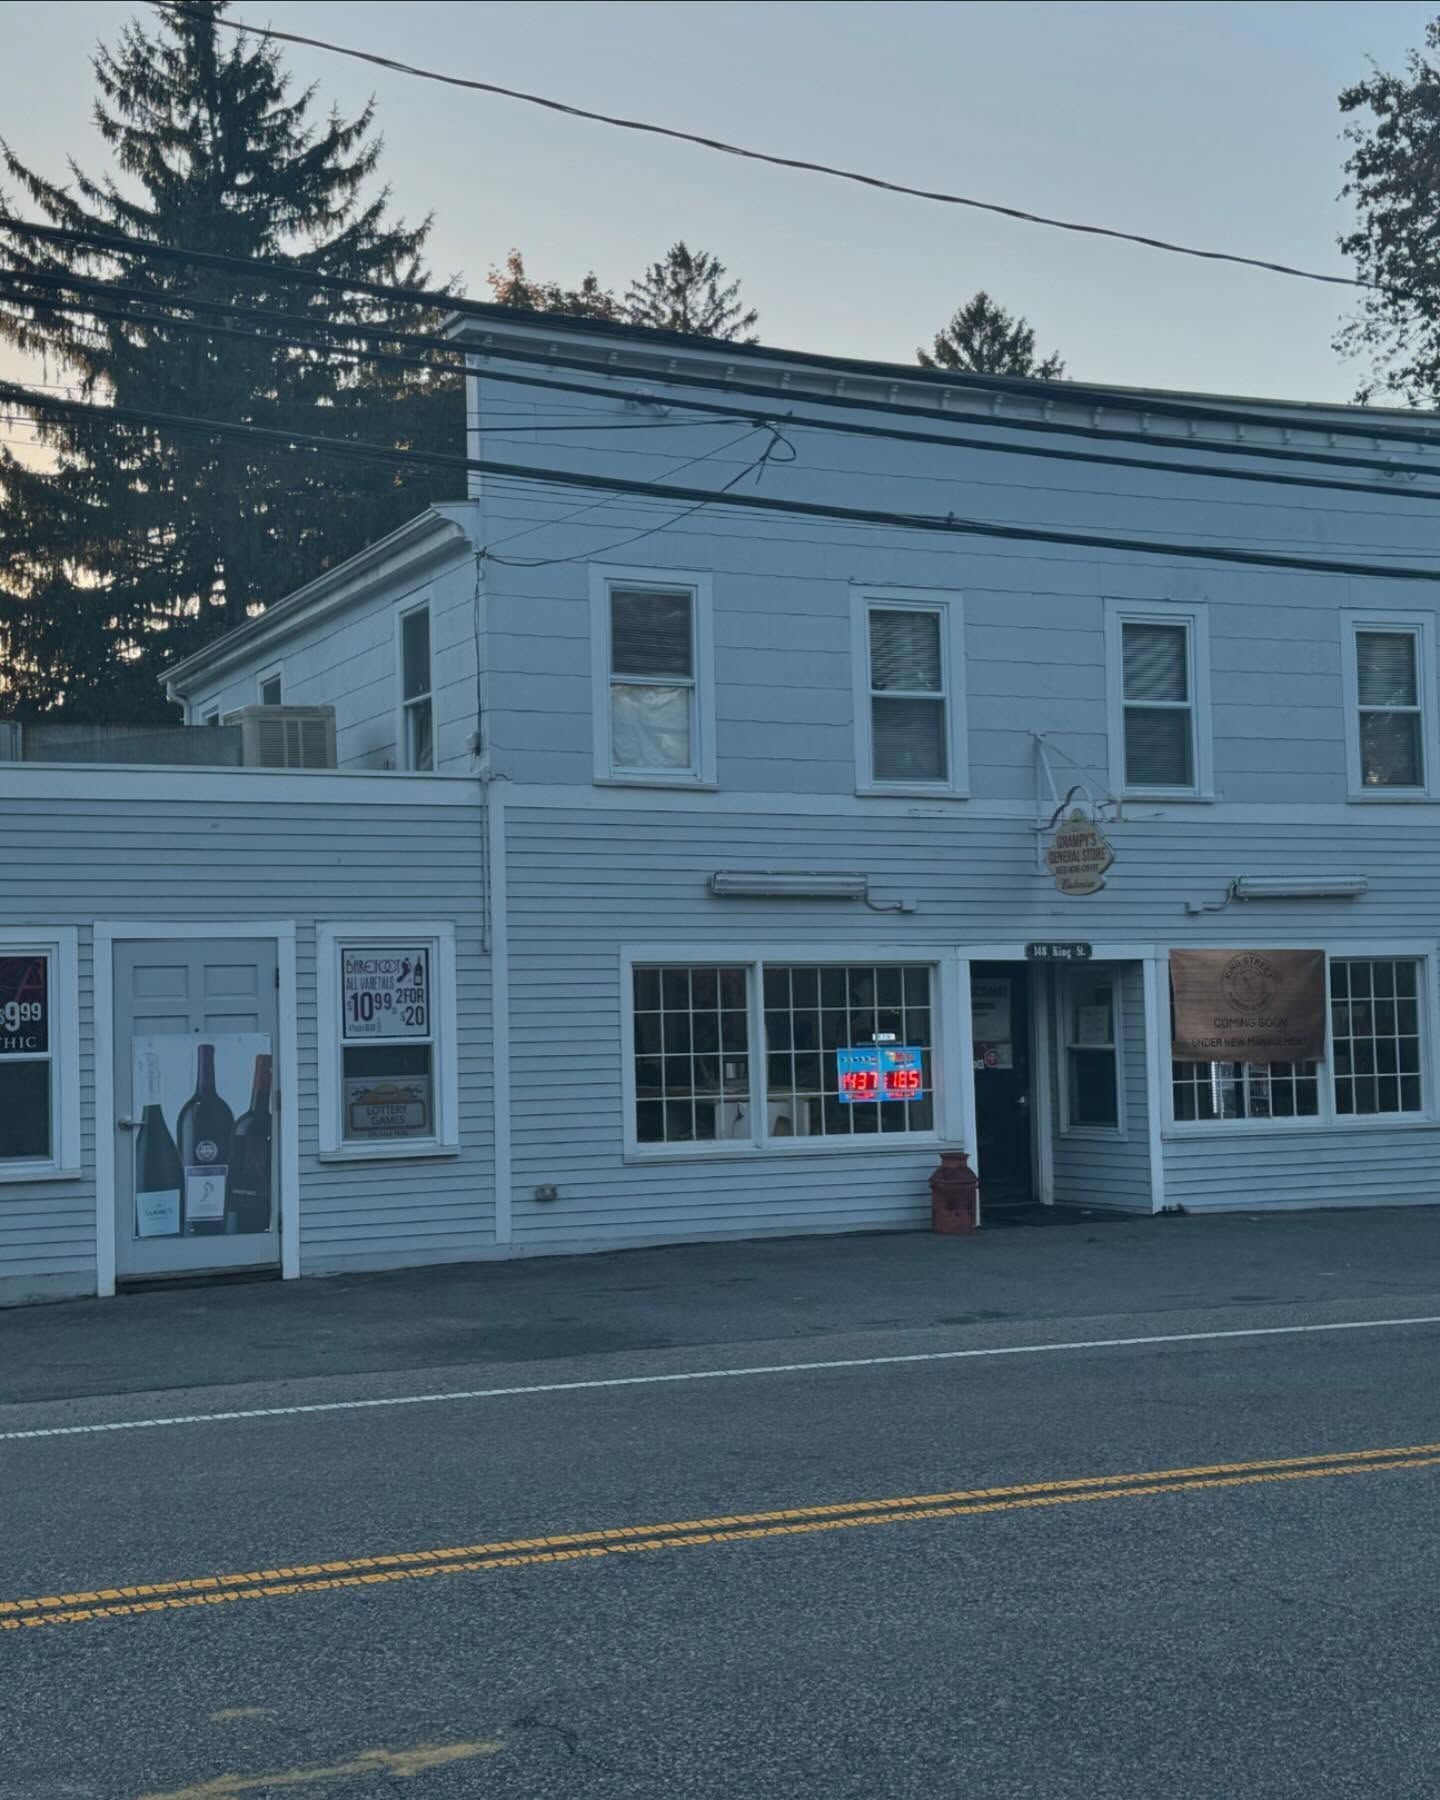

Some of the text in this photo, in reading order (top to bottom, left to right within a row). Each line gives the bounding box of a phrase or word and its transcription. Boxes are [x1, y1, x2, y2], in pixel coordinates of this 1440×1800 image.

[1048, 847, 1106, 865] GENERAL STORE
[1052, 945, 1072, 960] King
[346, 959, 401, 975] BAREFOOT
[346, 976, 360, 991] ALL
[400, 1005, 425, 1026] $20
[1213, 1016, 1289, 1030] COMING SOON
[0, 1036, 37, 1049] HIC
[1191, 1038, 1223, 1048] UNDER
[1224, 1038, 1245, 1048] NEW
[367, 1103, 409, 1115] LOTTERY
[370, 1114, 406, 1126] GAMES
